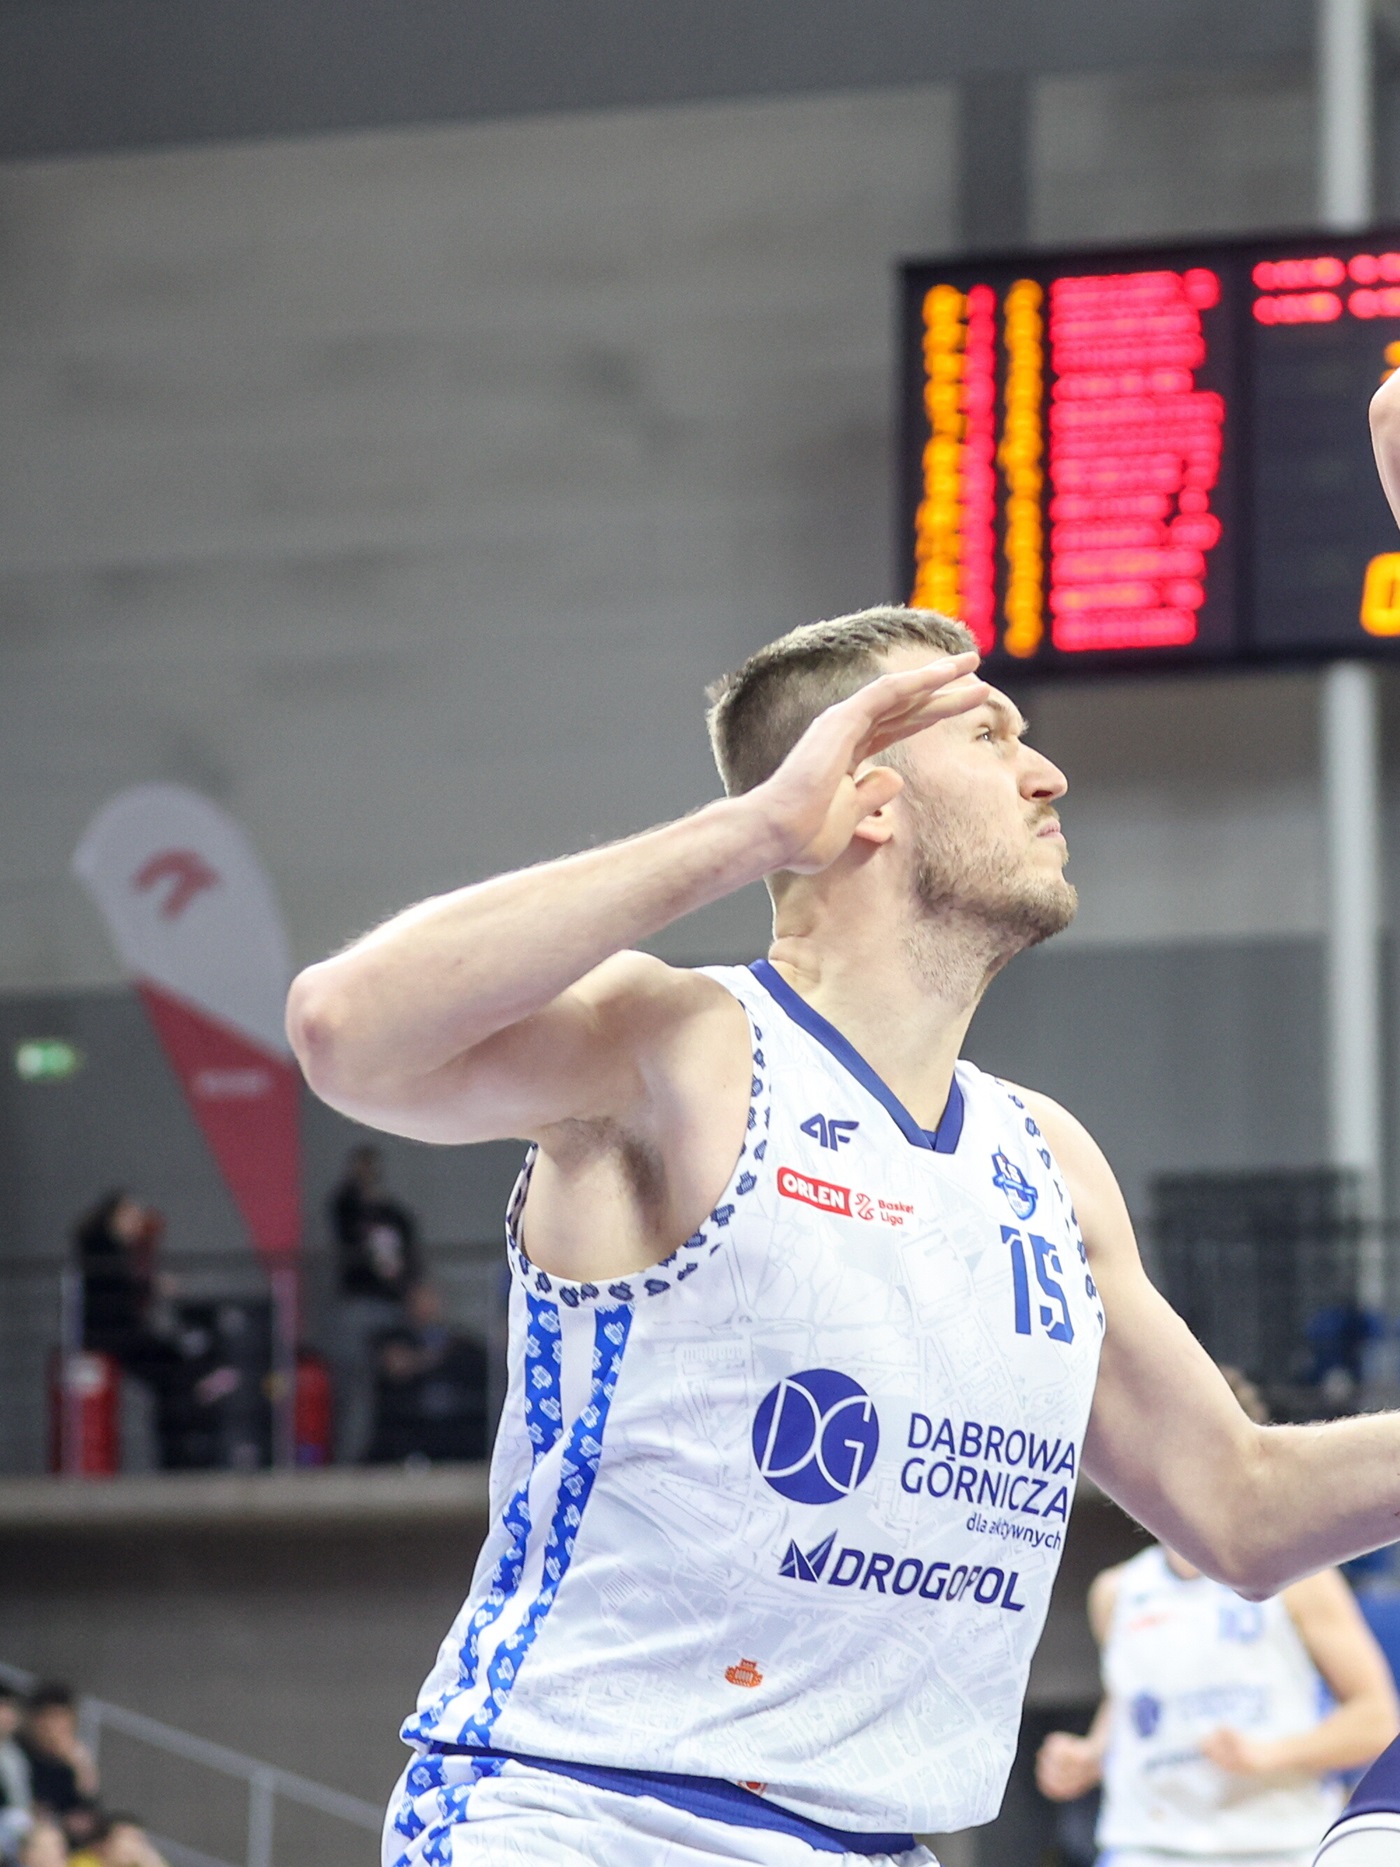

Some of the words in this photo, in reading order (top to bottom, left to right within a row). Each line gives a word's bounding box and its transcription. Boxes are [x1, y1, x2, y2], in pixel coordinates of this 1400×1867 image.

[782, 1172, 846, 1210] ORLEN
[877, 1199, 915, 1215] Basket
[879, 1212, 904, 1227] Liga
[1000, 1225, 1075, 1345] 15
[966, 1512, 987, 1534] dla
[827, 1547, 1026, 1612] DROGOPOL
